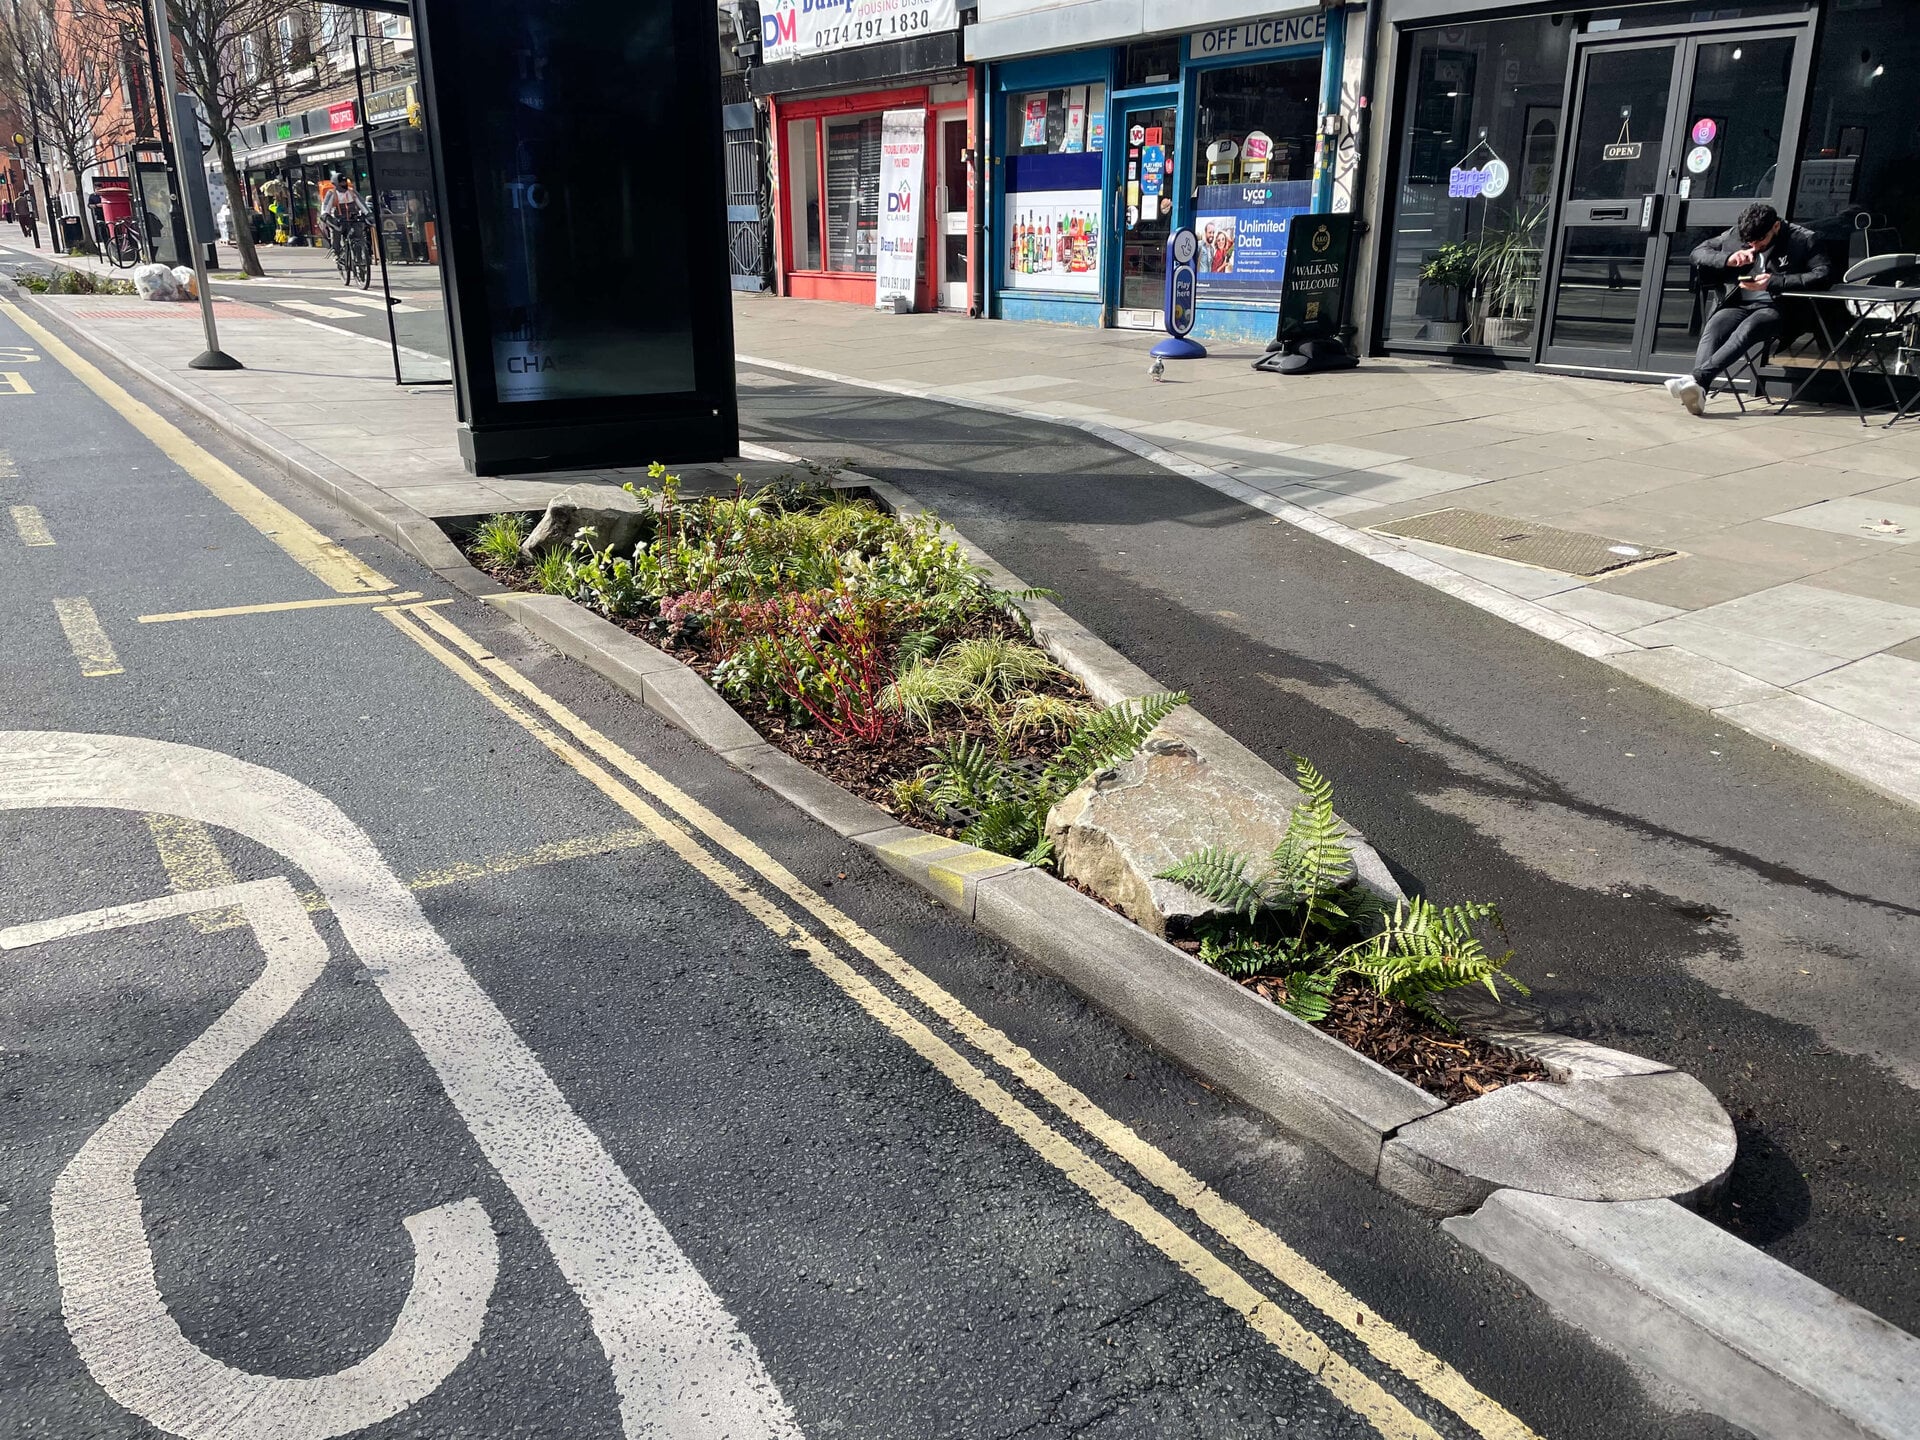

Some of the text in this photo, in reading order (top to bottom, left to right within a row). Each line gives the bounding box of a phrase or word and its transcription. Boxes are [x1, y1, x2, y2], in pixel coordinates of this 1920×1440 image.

[858, 0, 899, 17] HOUSING
[762, 9, 797, 48] DM
[815, 9, 929, 48] 0774 797 1830
[1202, 14, 1326, 52] OFF LICENCE
[1608, 147, 1634, 156] OPEN
[1451, 168, 1490, 182] Barber
[1242, 188, 1266, 202] Lyca
[1450, 184, 1481, 196] SHOP
[887, 192, 911, 213] DM
[887, 214, 910, 222] CLAIMS
[1239, 219, 1286, 233] Unlimited
[880, 236, 894, 256] Damp
[1238, 234, 1262, 248] Data
[1296, 263, 1339, 276] WALK-INS
[1177, 281, 1190, 290] Play
[1291, 277, 1340, 291] WELCOME!
[1176, 290, 1190, 298] here
